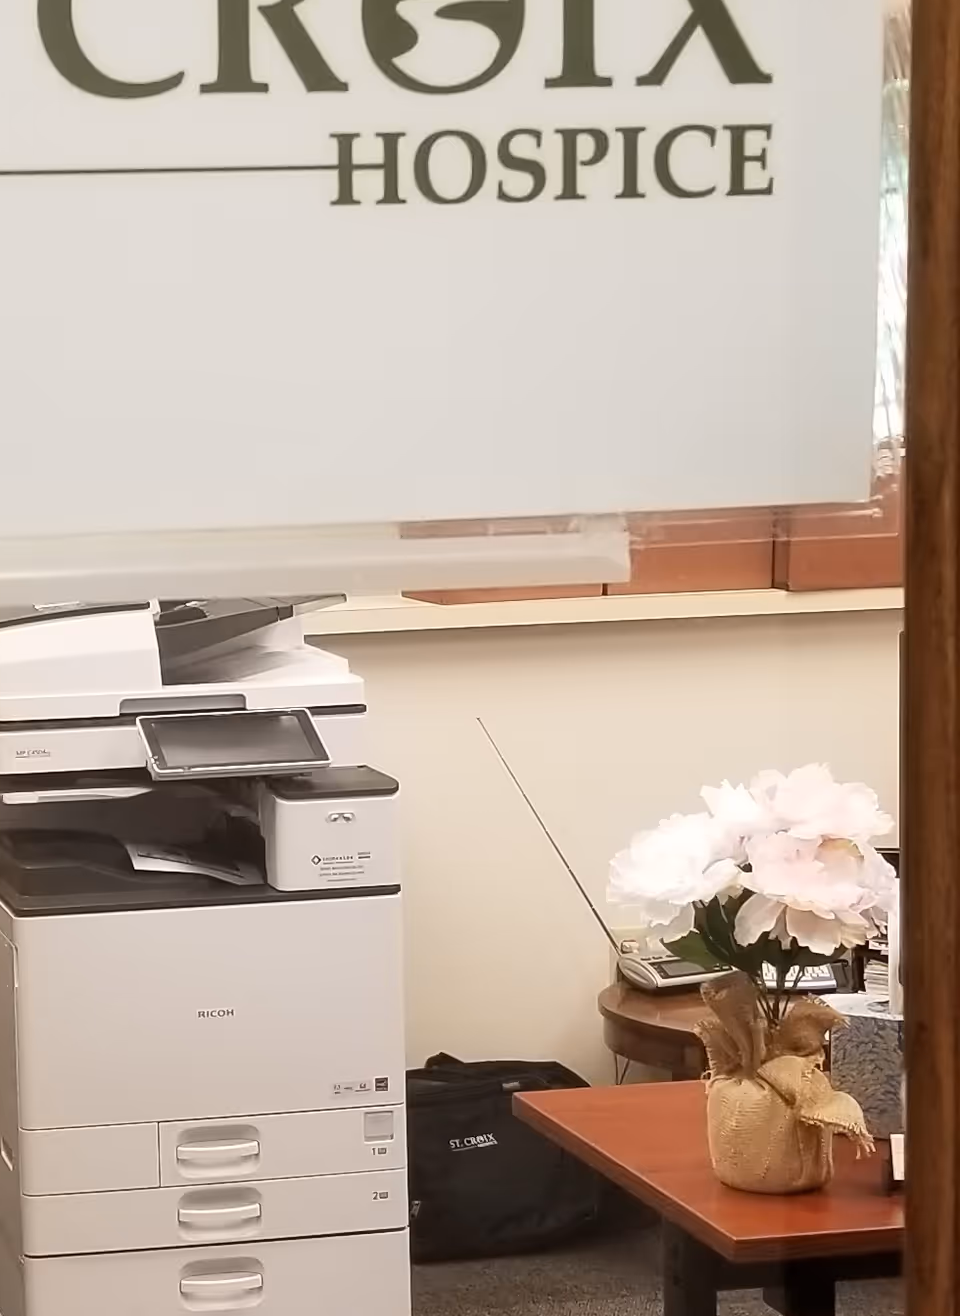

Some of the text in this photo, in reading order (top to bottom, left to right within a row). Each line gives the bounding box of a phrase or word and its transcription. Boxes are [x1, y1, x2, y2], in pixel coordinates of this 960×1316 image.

[328, 123, 776, 207] HOSPICE
[198, 1009, 234, 1018] RICOH
[449, 1139, 463, 1148] ST.
[464, 1133, 495, 1146] CROIX
[373, 1192, 378, 1200] 2
